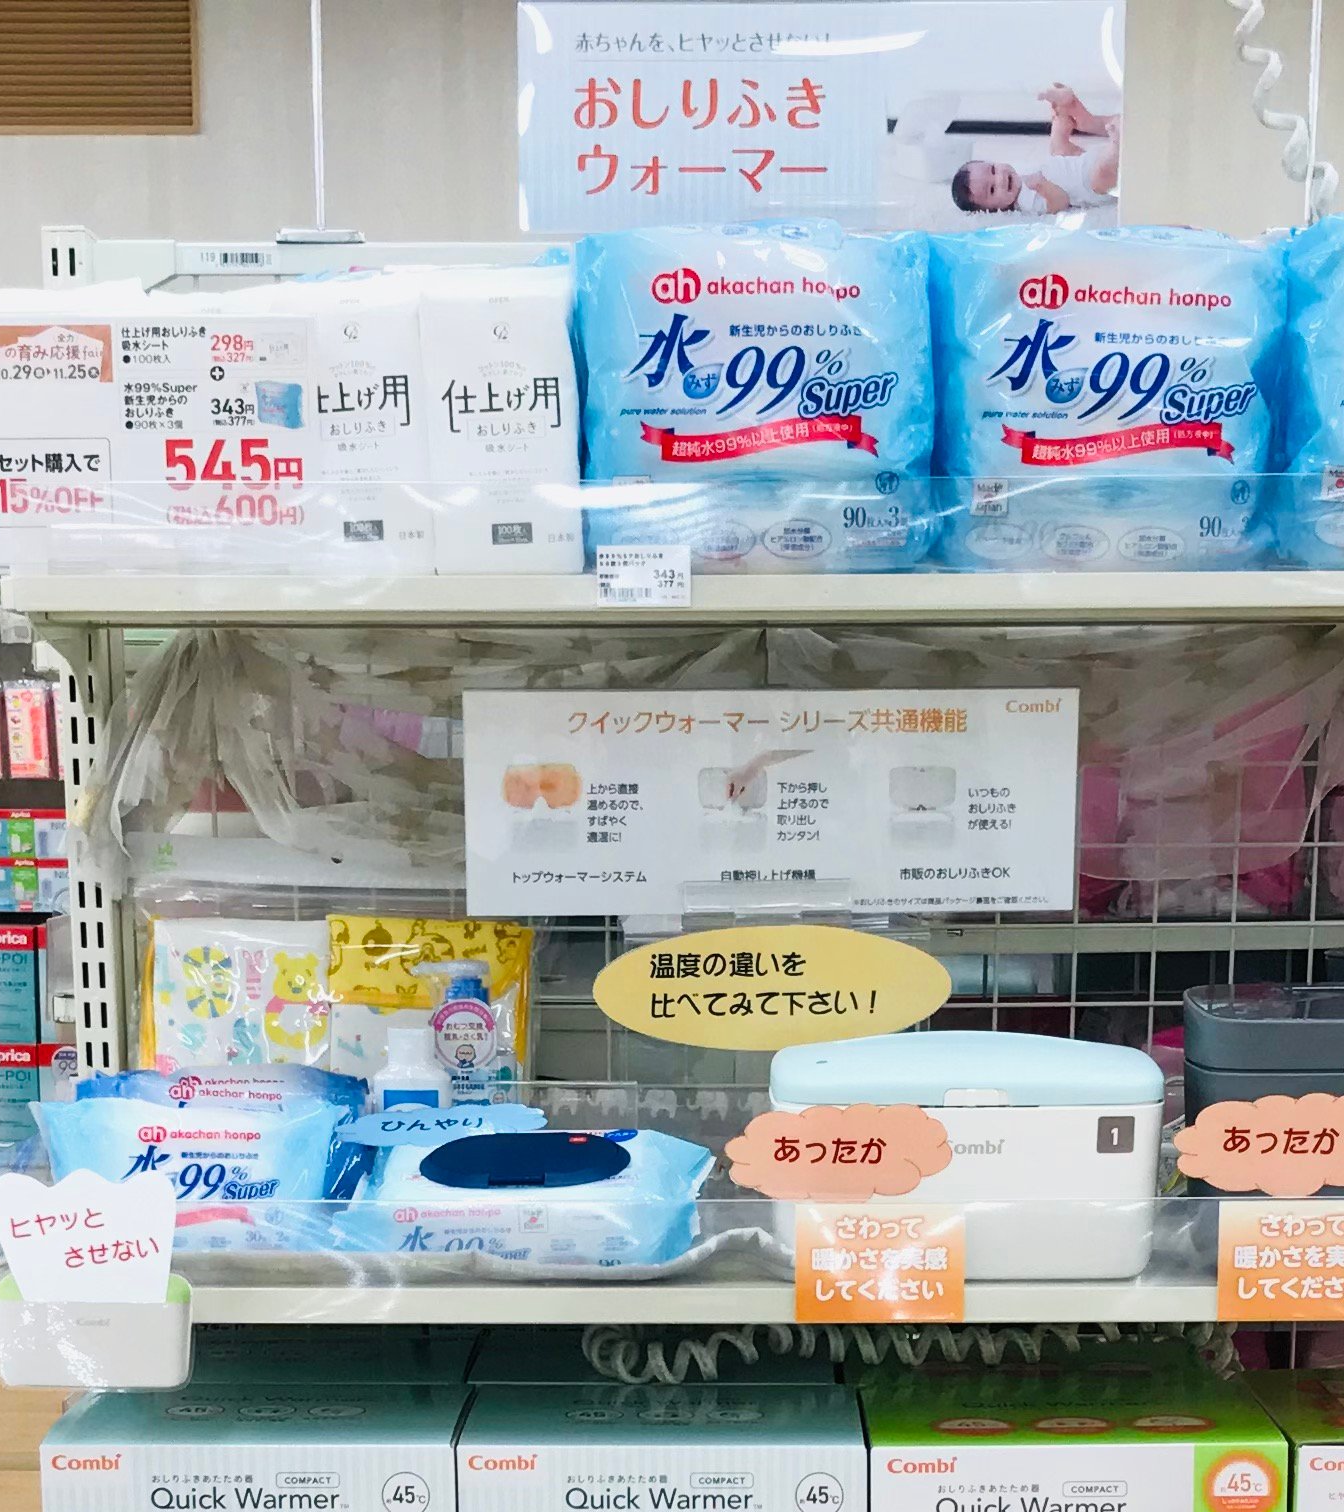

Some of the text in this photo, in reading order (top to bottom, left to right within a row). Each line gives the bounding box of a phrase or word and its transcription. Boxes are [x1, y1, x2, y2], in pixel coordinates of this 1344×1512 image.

[574, 77, 828, 130] おしりふき
[577, 145, 828, 196] ウォーマー
[1074, 288, 1161, 305] akachan
[1169, 289, 1231, 310] honpo
[122, 327, 206, 338] 仕上げ用おしりふき
[122, 340, 169, 350] 吸水シート
[210, 335, 254, 351] 298円
[124, 383, 198, 394] 水99%Super
[799, 372, 899, 419] Super
[125, 395, 187, 406] 新生児からの
[211, 399, 254, 415] 343円
[125, 407, 173, 418] おしりふき
[329, 420, 387, 436] おしりふき
[476, 421, 537, 437] おしりふき
[165, 439, 303, 491] 545円
[568, 709, 968, 733] クイックウォーマー シリーズ共通機能
[587, 784, 639, 794] 上から直接
[777, 782, 828, 793] 下から押し
[968, 788, 1010, 798] いつもの
[777, 799, 829, 809] 上げるので
[968, 803, 1016, 814] おしりふき
[587, 816, 627, 826] すばやく
[777, 815, 816, 825] 取り出し
[512, 872, 647, 883] トップウォーマーシステム
[900, 868, 1010, 880] 市販のおしりふきOK
[650, 952, 806, 978] 温度の違いを
[382, 1117, 483, 1131] ひんやり
[170, 1131, 220, 1139] akachan
[225, 1130, 261, 1140] honpo
[1110, 1128, 1120, 1145] 1
[1223, 1127, 1339, 1156] あったか
[774, 1138, 887, 1164] あったか
[10, 1206, 106, 1239] ヒヤッと
[835, 1216, 924, 1240] さわって
[65, 1238, 160, 1268] させない
[814, 1279, 944, 1302] してください
[1071, 1485, 1119, 1493] COMPACT
[151, 1487, 340, 1510] Quick Warmer
[566, 1487, 753, 1510] Quick Warmer
